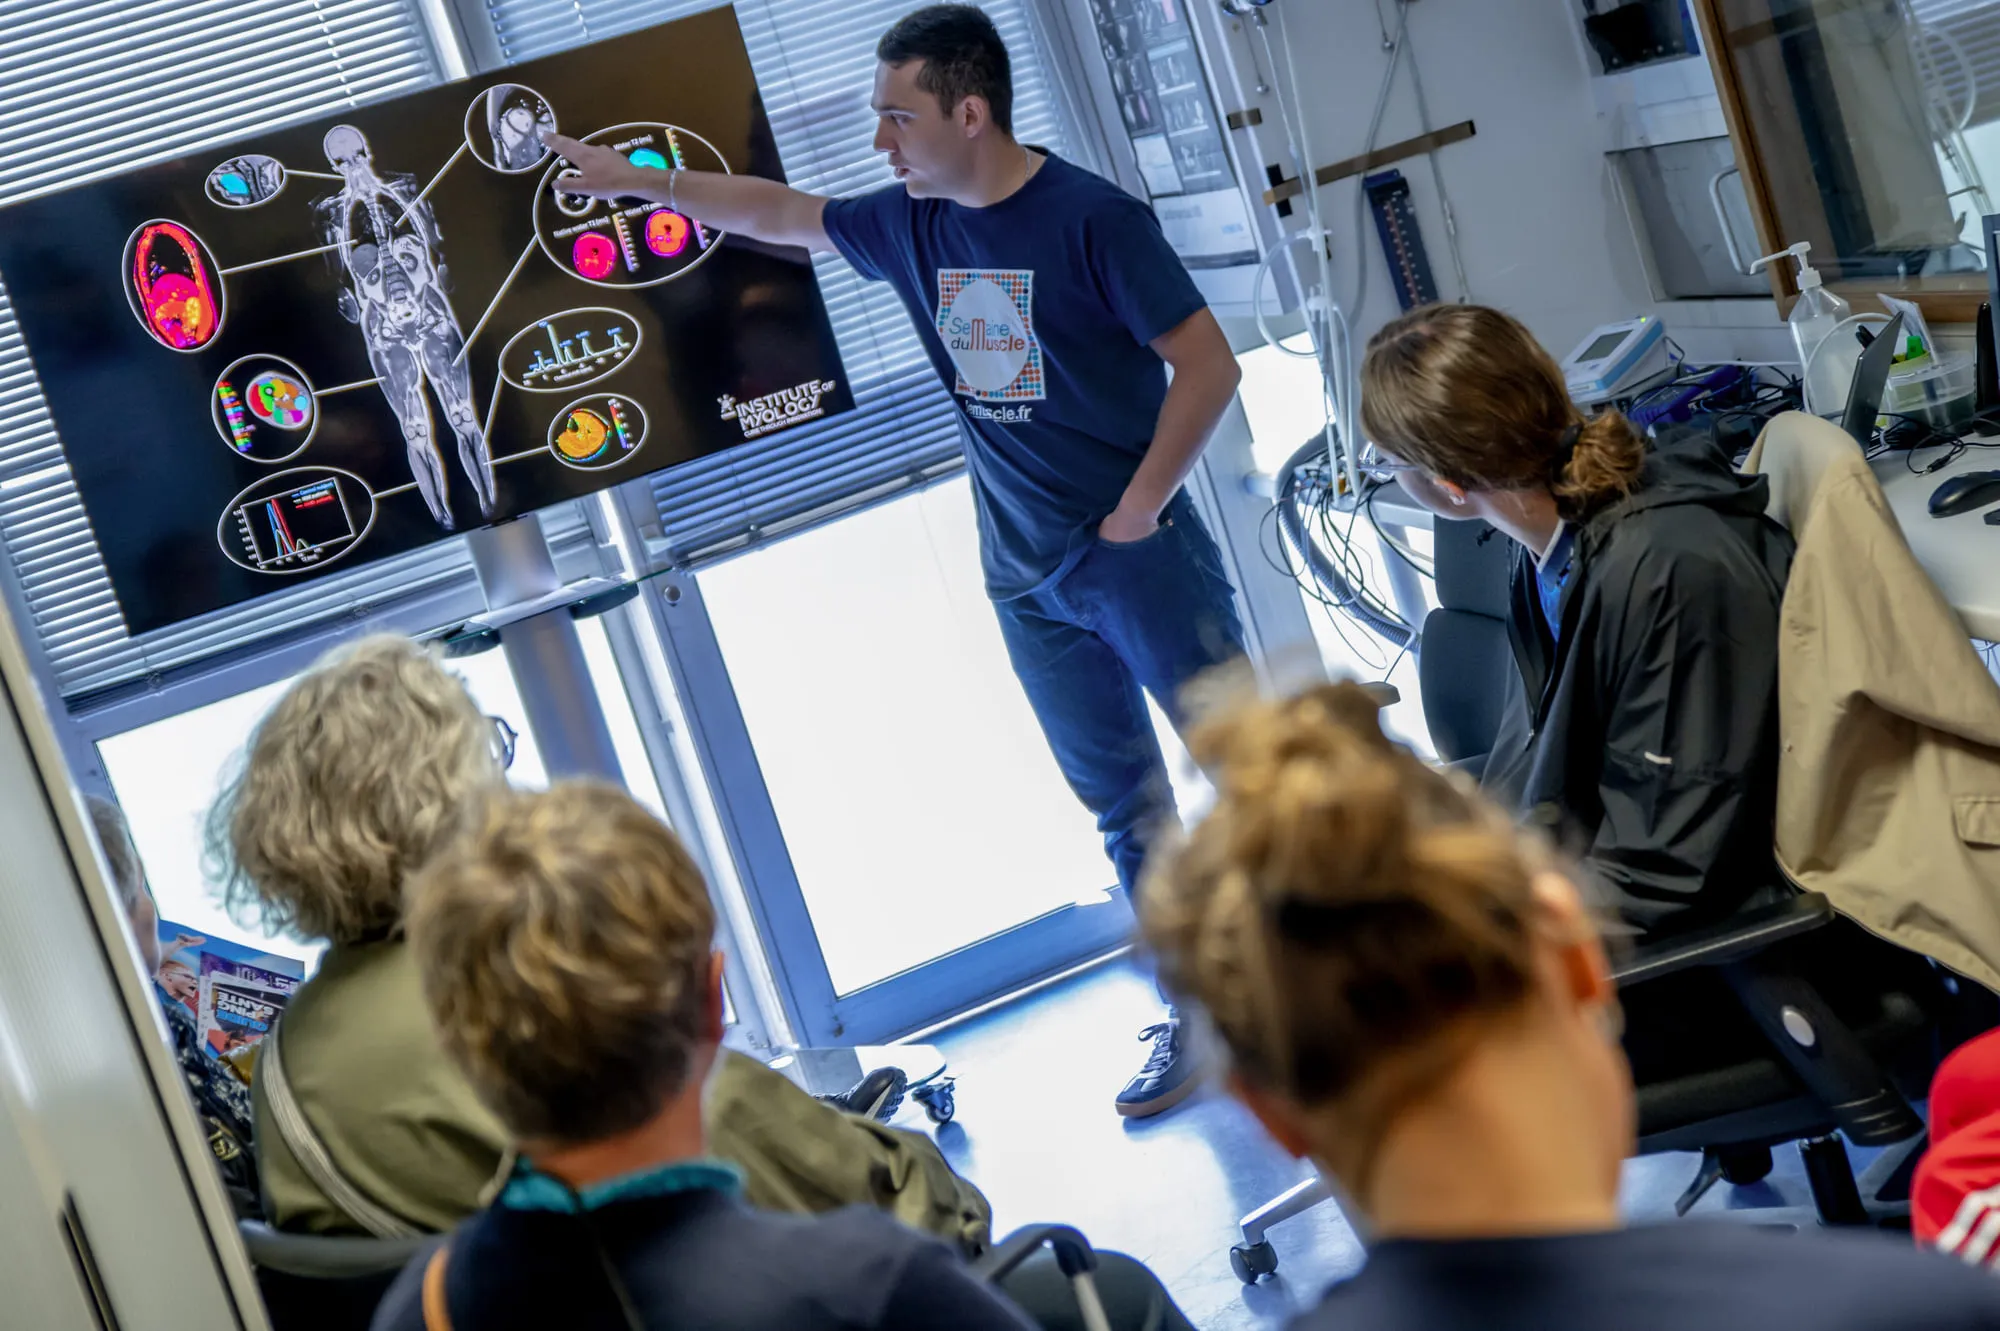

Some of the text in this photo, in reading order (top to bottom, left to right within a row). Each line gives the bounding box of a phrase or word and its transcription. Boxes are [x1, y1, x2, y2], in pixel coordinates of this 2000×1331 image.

[736, 379, 836, 417] INSTITUTE OF
[739, 394, 821, 430] MYOLOGY
[759, 420, 786, 433] THROUGH
[215, 1008, 269, 1031] GUIDE
[217, 1000, 256, 1019] PING
